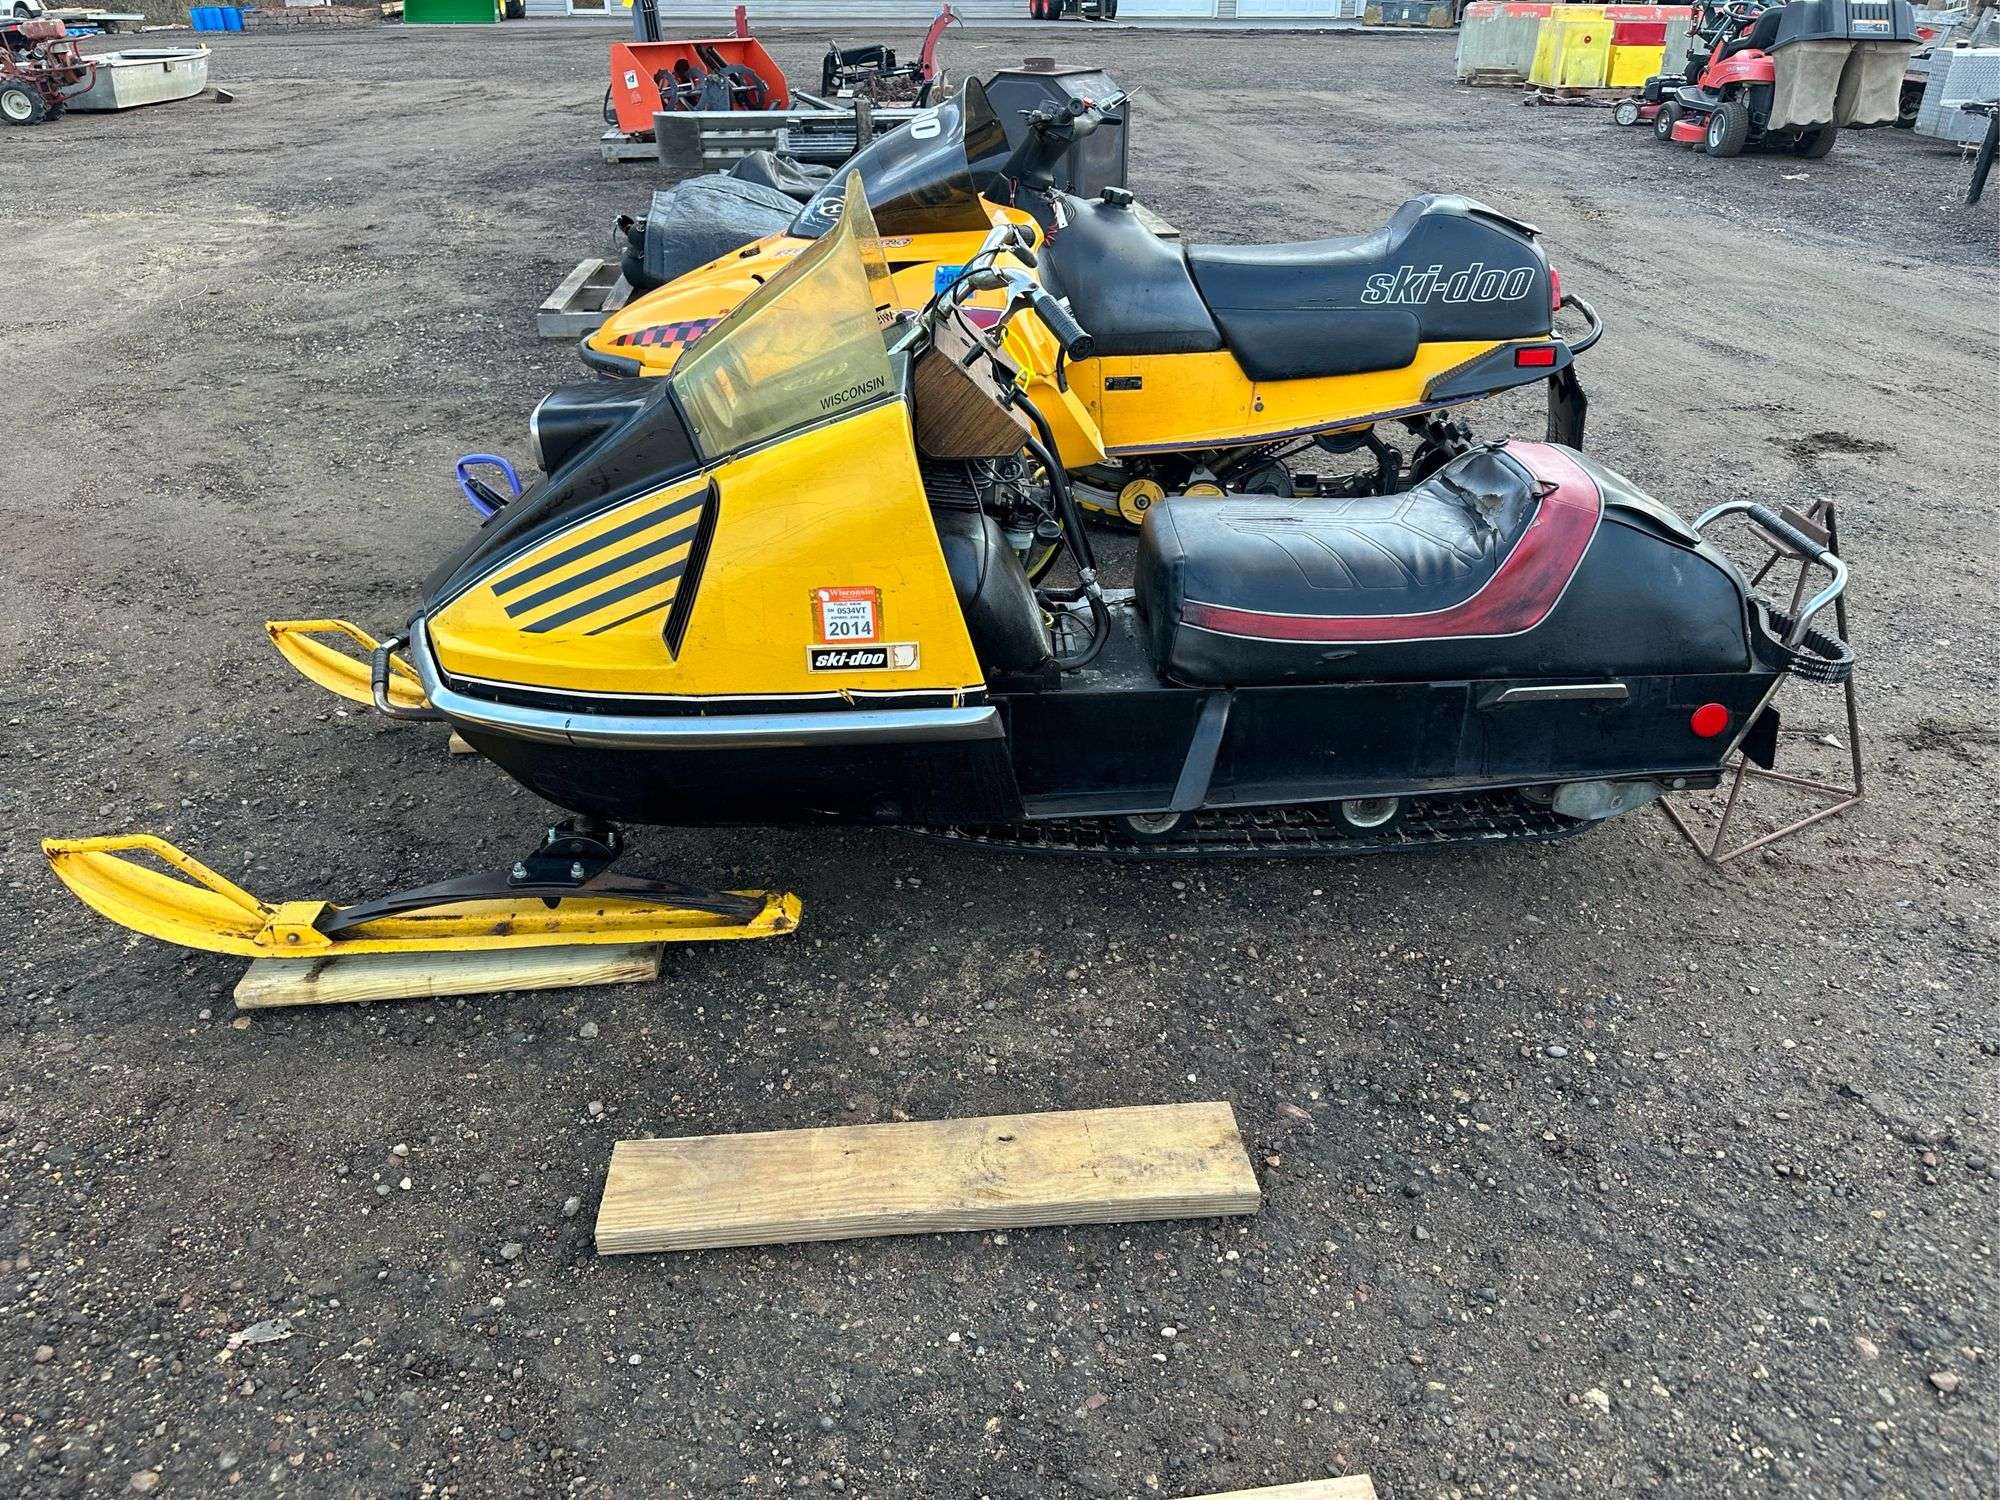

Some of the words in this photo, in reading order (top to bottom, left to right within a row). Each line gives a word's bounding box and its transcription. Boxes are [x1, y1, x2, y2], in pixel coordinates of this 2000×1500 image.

[1360, 263, 1536, 304] ski-doo
[819, 375, 885, 410] WISCONSIN
[829, 621, 872, 636] 2014
[815, 651, 885, 667] ski-doo
